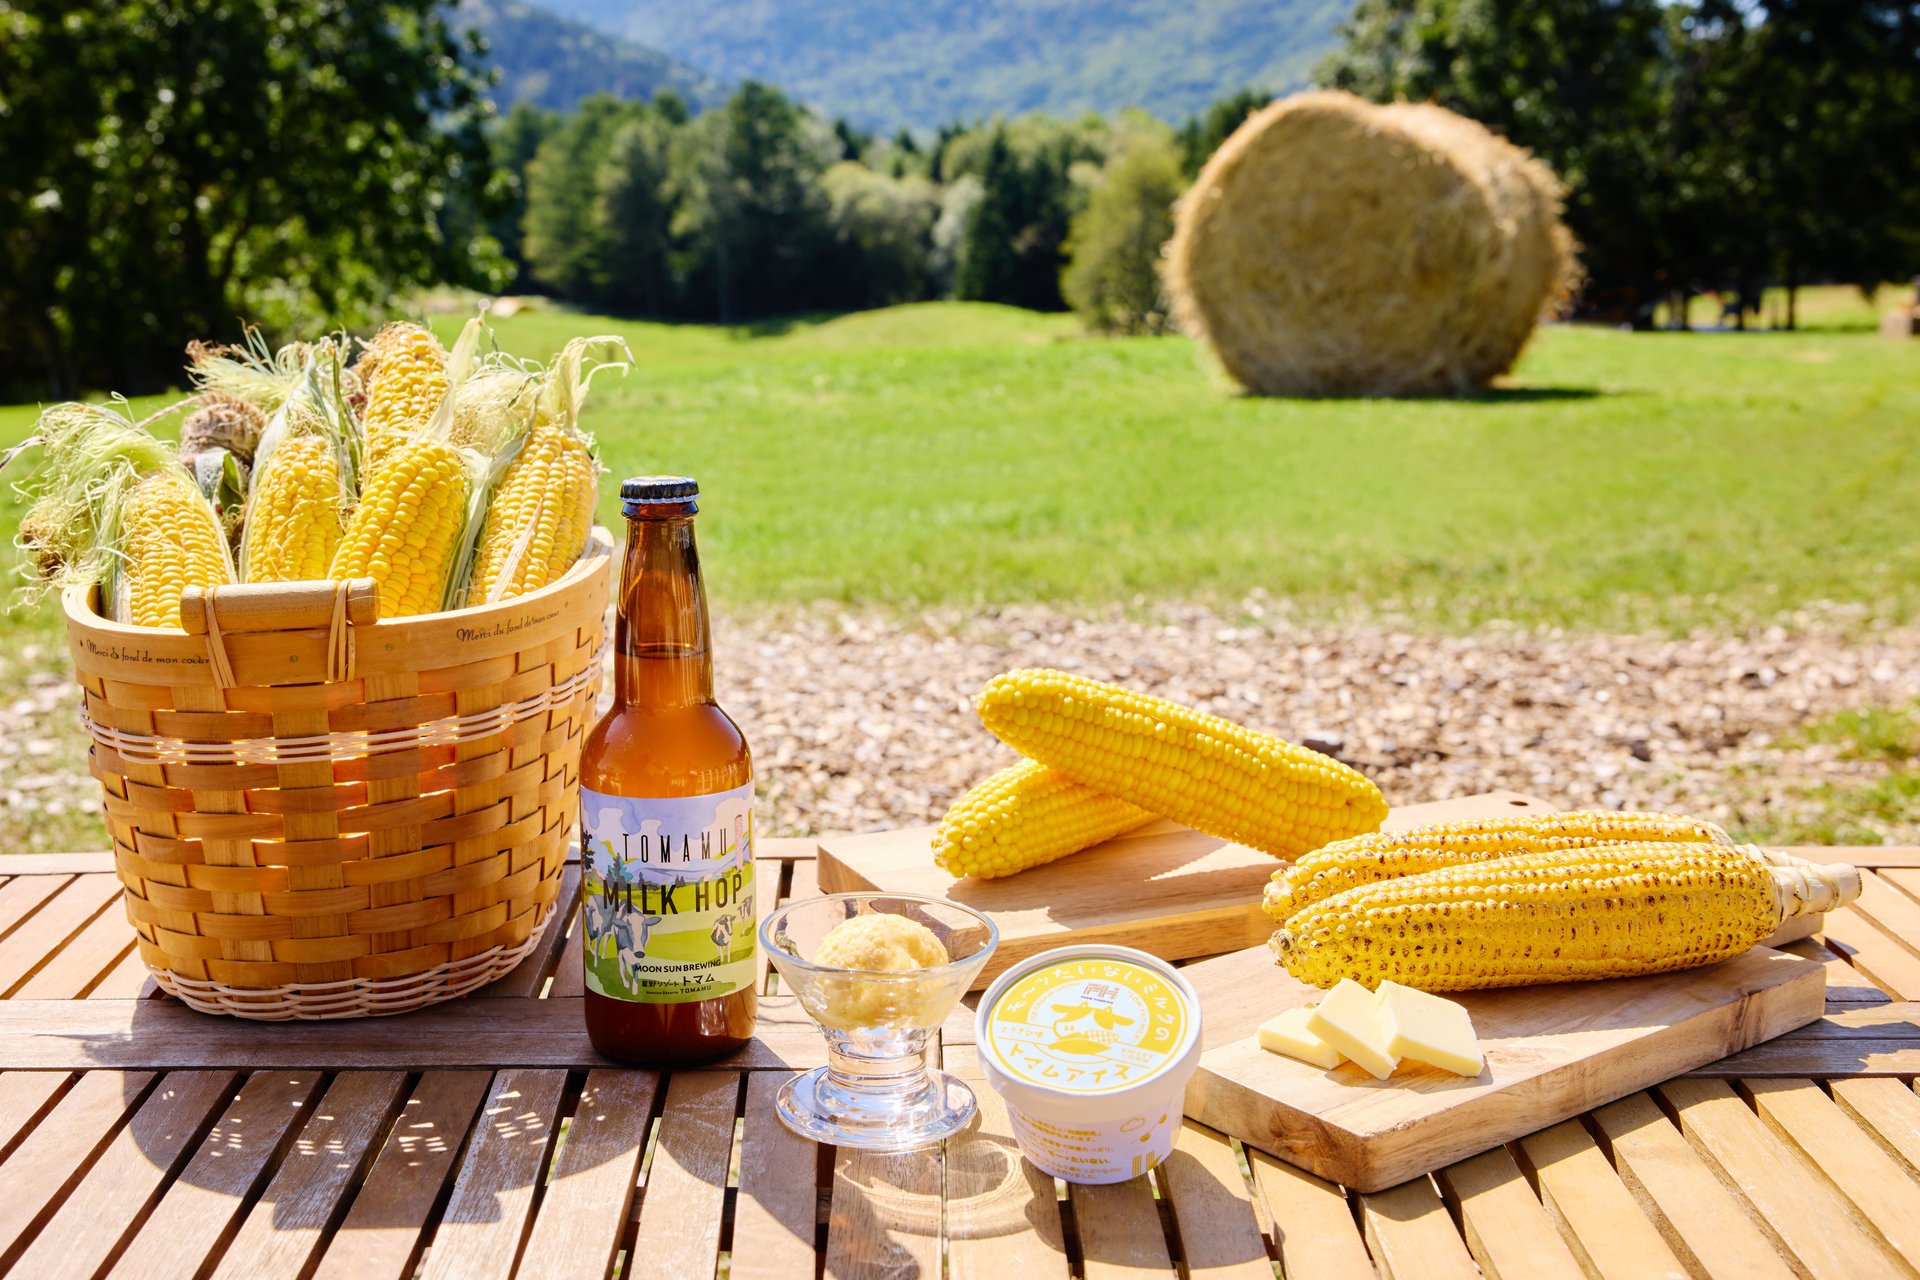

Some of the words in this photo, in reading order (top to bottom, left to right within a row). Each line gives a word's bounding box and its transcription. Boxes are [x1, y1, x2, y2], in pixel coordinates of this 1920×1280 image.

[456, 628, 491, 642] Merci
[493, 623, 504, 636] du
[506, 619, 523, 635] fond
[524, 616, 532, 627] de
[87, 638, 108, 657] Merci
[121, 646, 140, 662] fond
[142, 650, 153, 663] de
[623, 828, 728, 863] TOMAMU
[603, 880, 679, 915] MILK
[695, 873, 743, 912] HOP
[634, 965, 662, 973] MOON
[663, 965, 682, 973] SUN
[683, 959, 721, 972] BREWING
[680, 985, 712, 994] TOMAMU
[683, 973, 715, 986] トマム
[1009, 1043, 1130, 1083] トマムアイス
